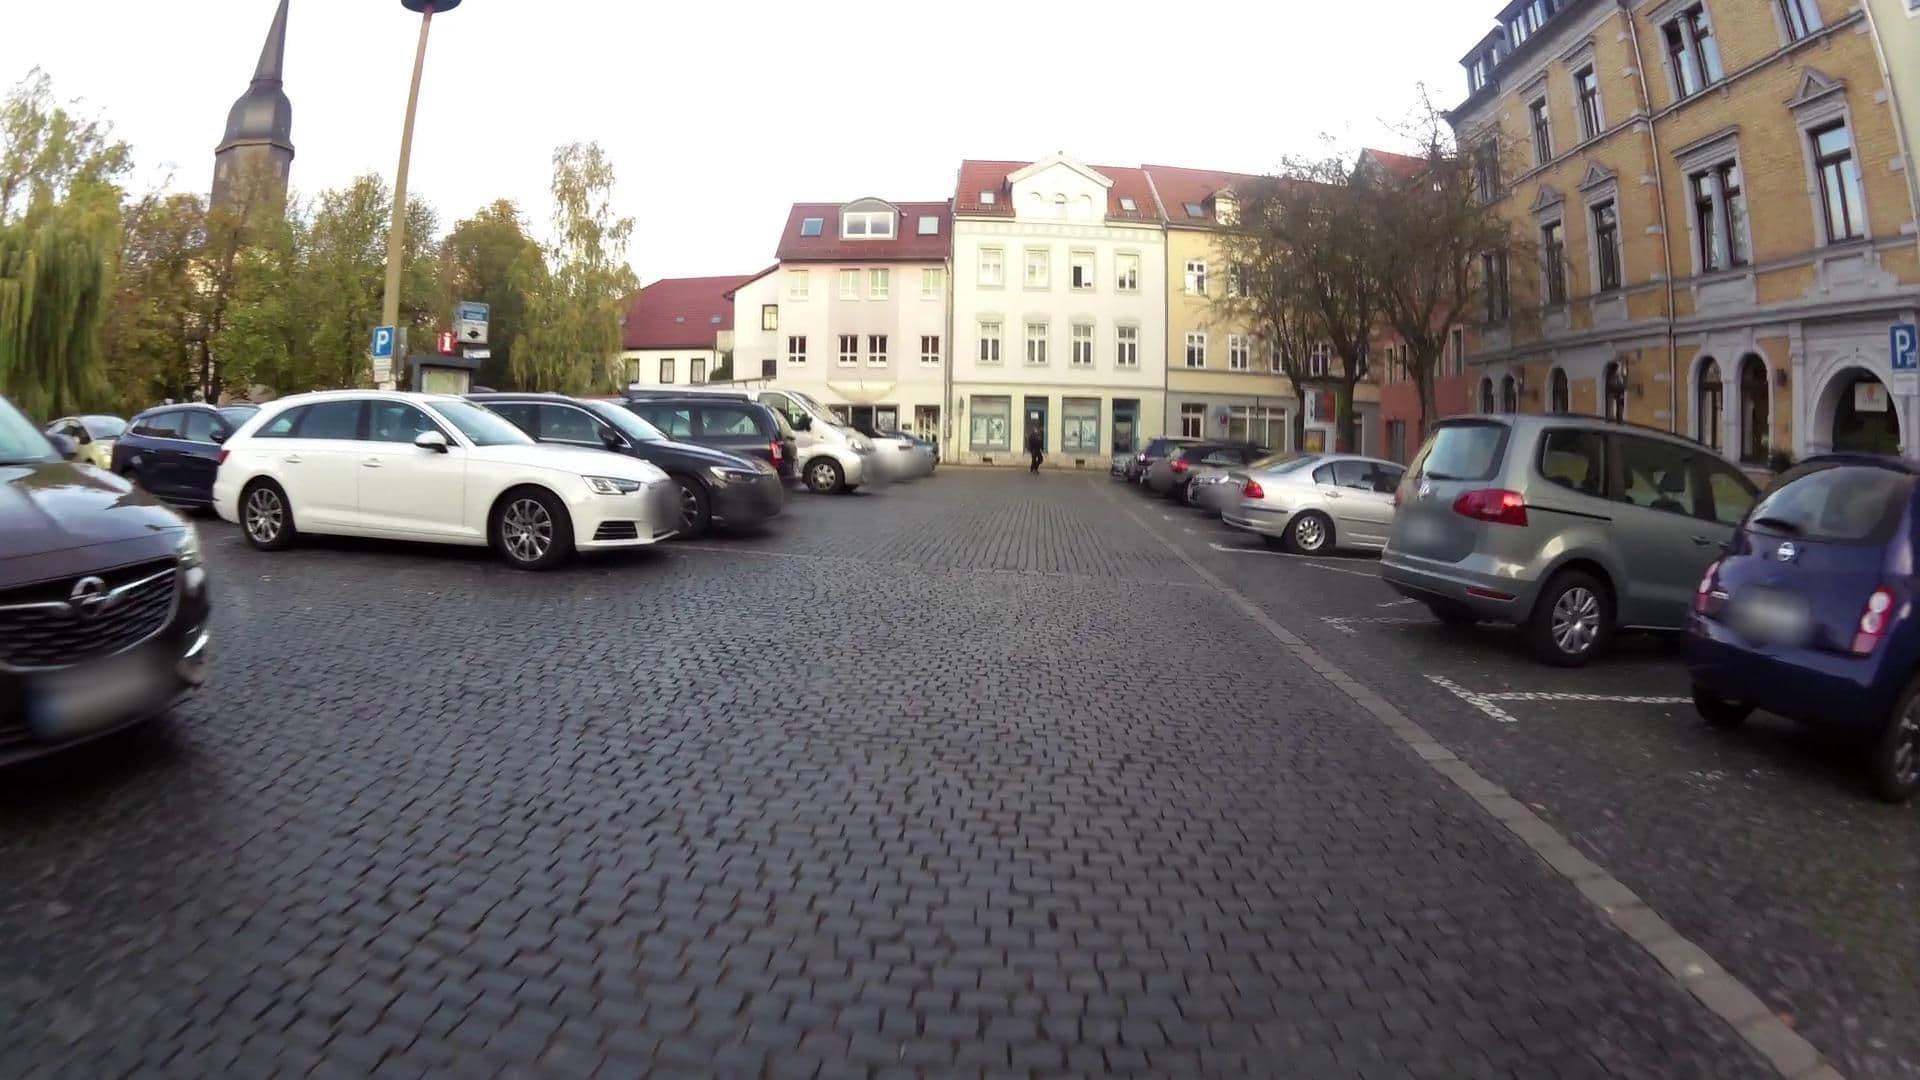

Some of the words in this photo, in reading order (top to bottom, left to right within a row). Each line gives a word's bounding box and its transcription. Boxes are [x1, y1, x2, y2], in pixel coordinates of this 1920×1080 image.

[376, 330, 389, 353] P
[443, 332, 452, 351] i
[1895, 329, 1910, 365] P
